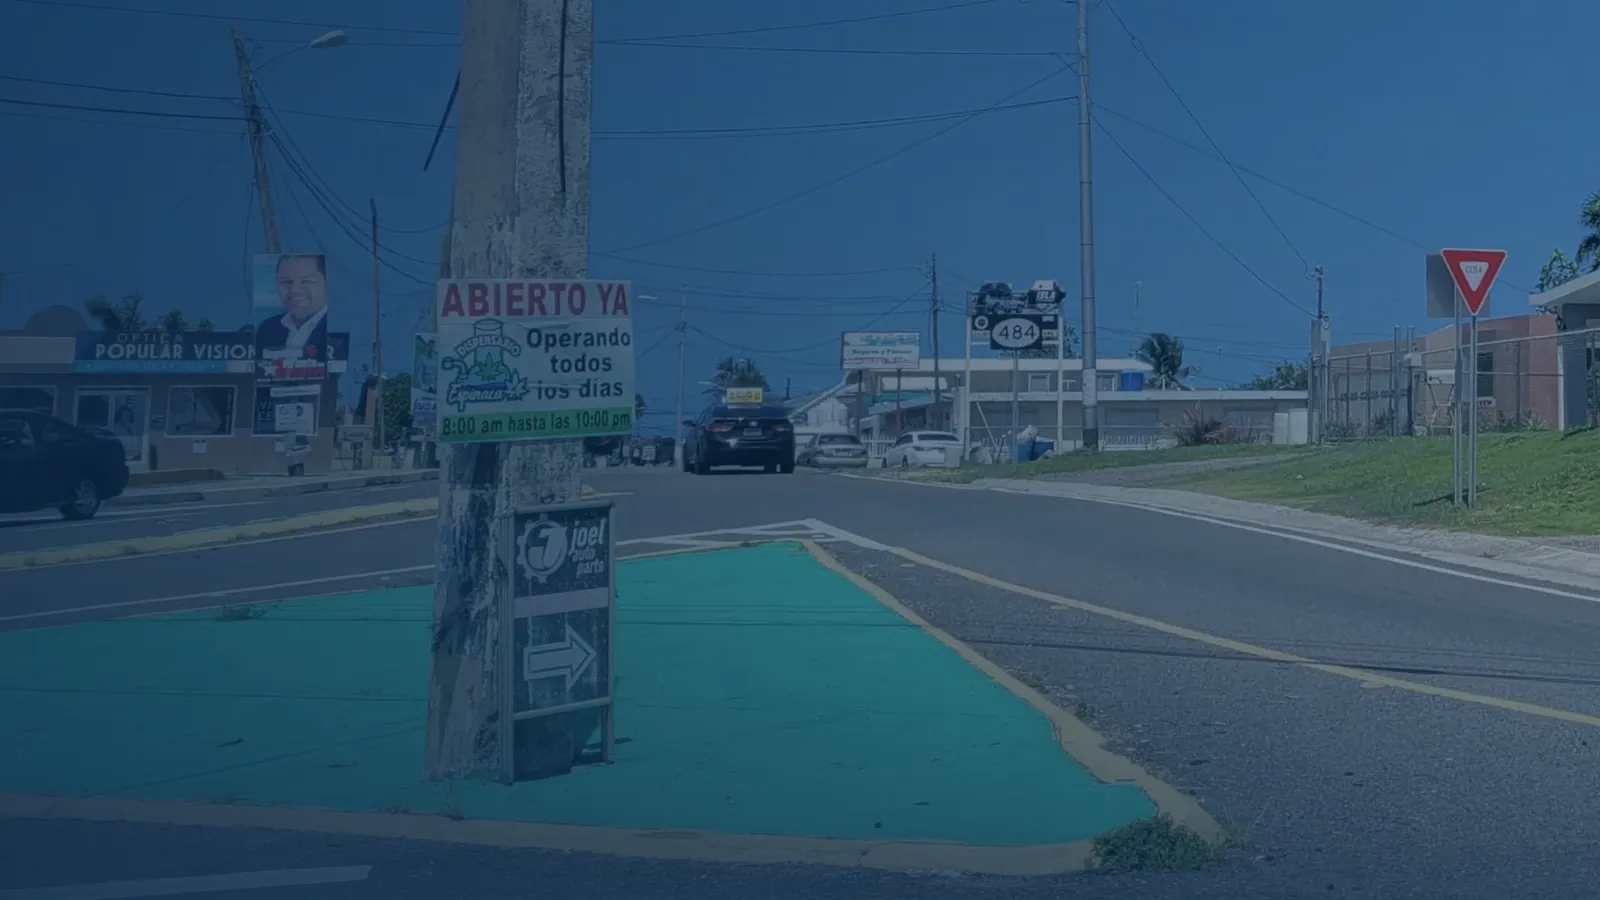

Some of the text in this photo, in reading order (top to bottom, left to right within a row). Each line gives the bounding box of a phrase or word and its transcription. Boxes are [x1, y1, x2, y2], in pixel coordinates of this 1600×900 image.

[441, 282, 629, 317] ABIERTO YA
[1035, 291, 1056, 302] ISLA
[526, 327, 631, 353] Operando
[998, 324, 1036, 341] 484
[95, 343, 183, 360] POPULAR
[193, 343, 255, 360] VISION
[550, 353, 613, 374] todos
[578, 377, 624, 398] días
[442, 410, 631, 436] 8:00 am hasta las 10:00 pm
[568, 519, 606, 556] joel
[573, 547, 596, 562] auto
[577, 558, 605, 578] parts
